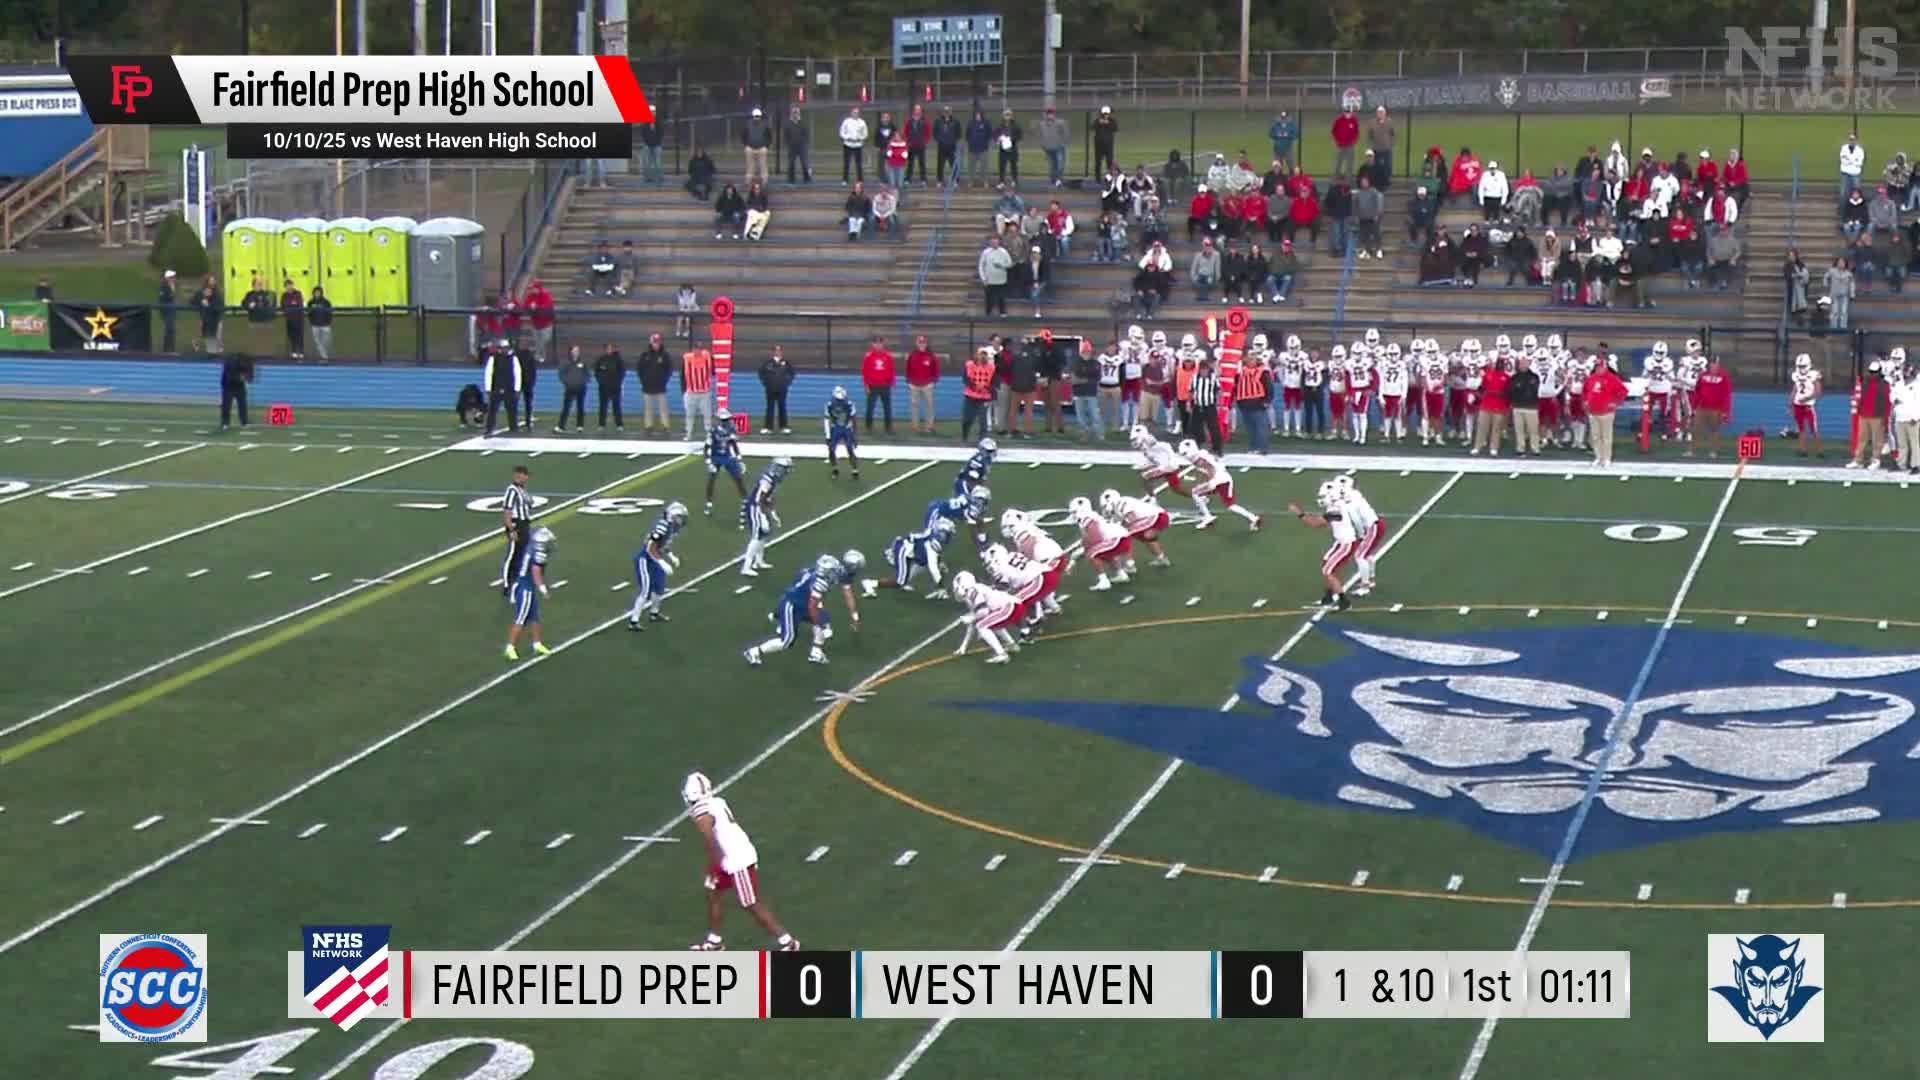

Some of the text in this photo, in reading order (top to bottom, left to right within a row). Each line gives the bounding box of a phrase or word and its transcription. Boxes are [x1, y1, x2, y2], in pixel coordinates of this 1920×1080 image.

[36, 98, 60, 109] PRESS
[1385, 371, 1399, 383] 27
[1541, 373, 1548, 384] 7
[1800, 384, 1806, 394] 2
[1740, 439, 1760, 457] 50
[1603, 523, 1818, 546] 50
